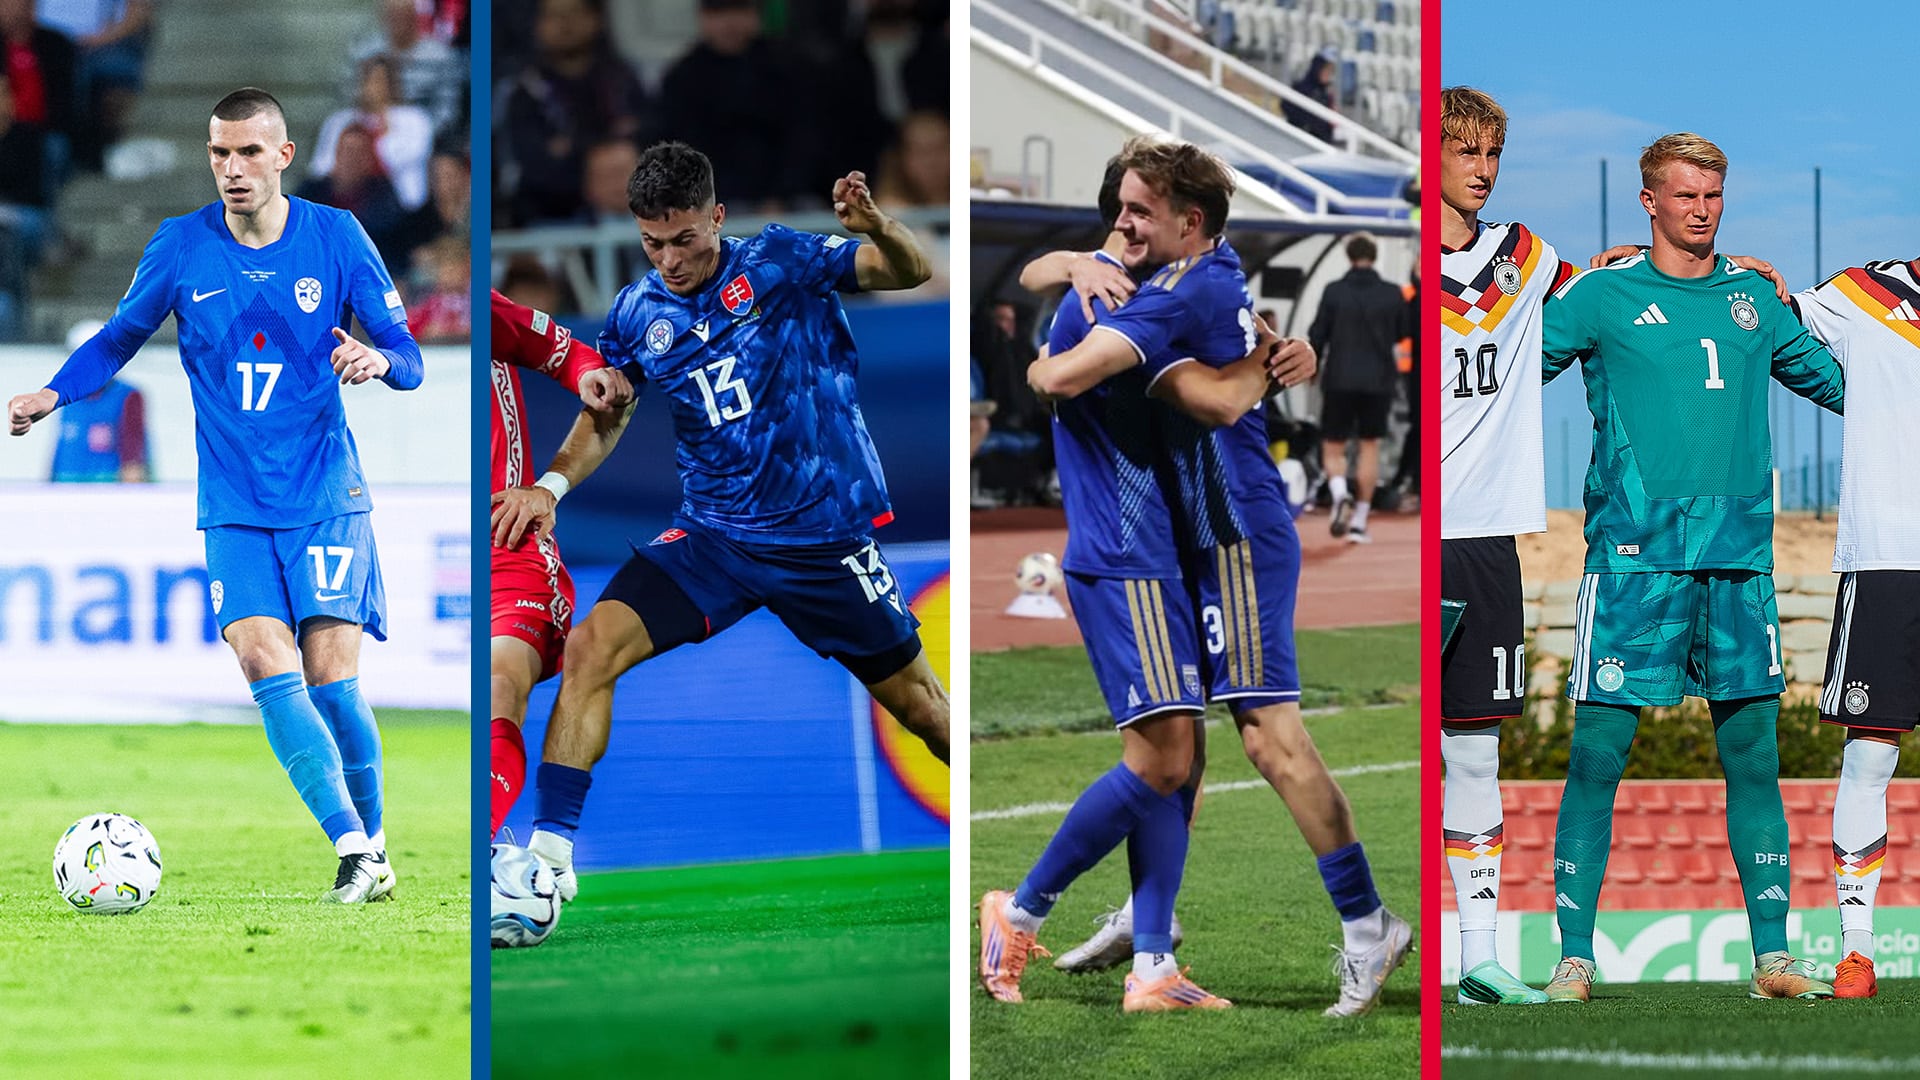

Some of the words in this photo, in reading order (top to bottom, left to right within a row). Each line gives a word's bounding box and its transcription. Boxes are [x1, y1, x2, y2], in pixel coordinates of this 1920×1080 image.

[237, 363, 283, 411] 17
[1454, 343, 1499, 398] 10
[1701, 339, 1725, 389] 1
[688, 356, 752, 427] 13
[308, 547, 354, 590] 17
[841, 543, 893, 603] 13
[514, 599, 546, 612] JAKO
[511, 621, 541, 639] JAKO
[1766, 623, 1781, 676] 1
[1493, 644, 1525, 700] 10
[1470, 867, 1496, 879] DFB
[1754, 852, 1788, 866] DFB
[1803, 931, 1835, 955] La
